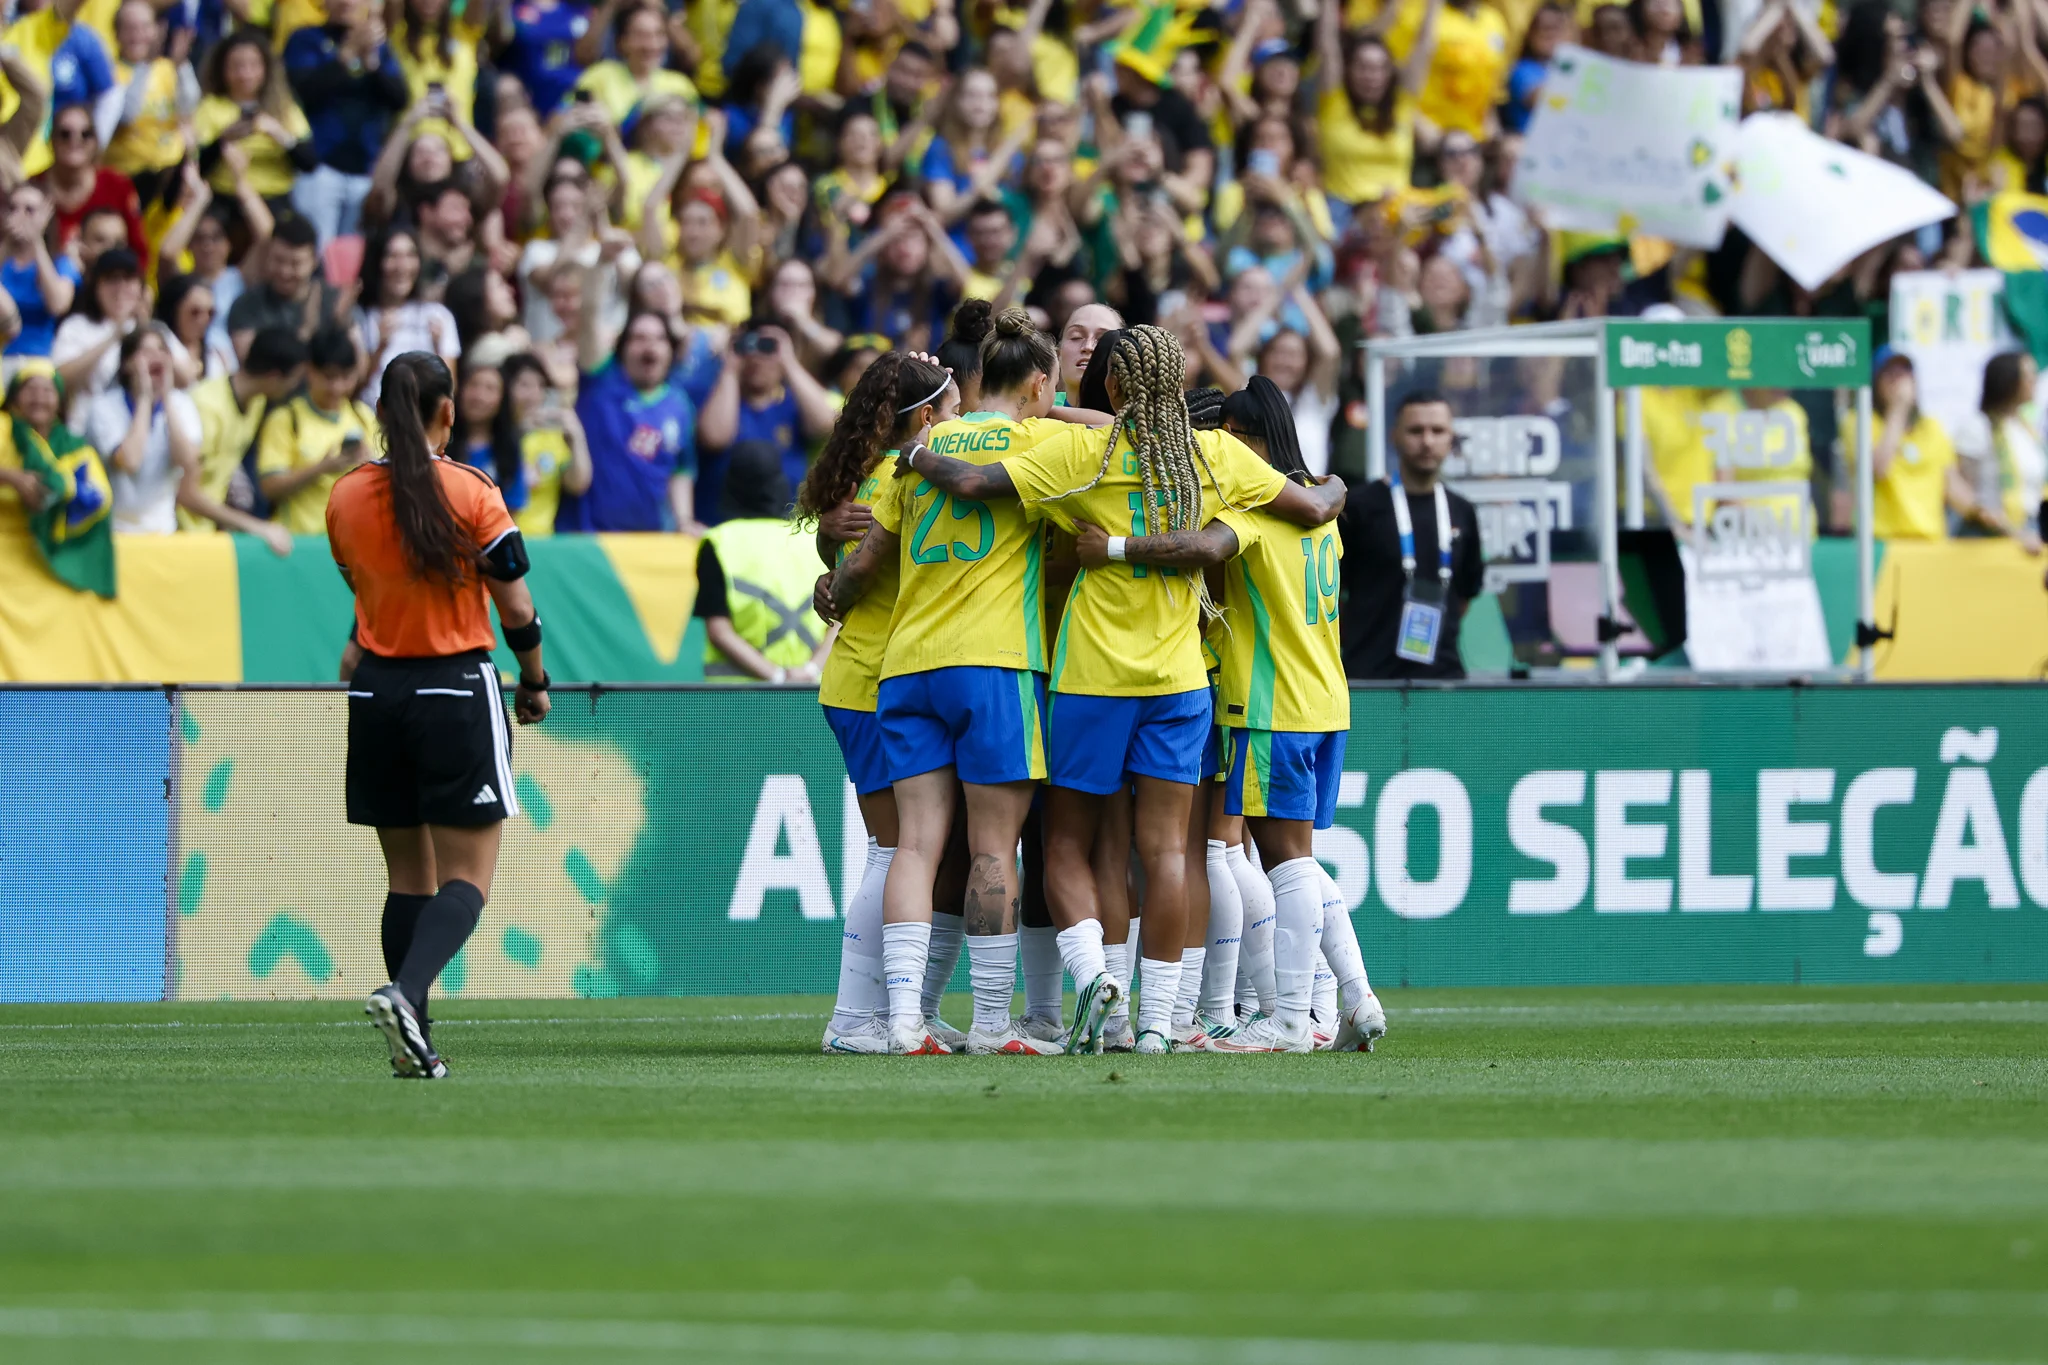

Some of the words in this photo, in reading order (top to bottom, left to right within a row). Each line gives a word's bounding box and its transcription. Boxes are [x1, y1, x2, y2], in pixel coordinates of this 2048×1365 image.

[931, 427, 1011, 456] NIEHUES
[910, 479, 995, 565] 25
[1301, 533, 1340, 625] 19
[1215, 937, 1241, 945] BRA
